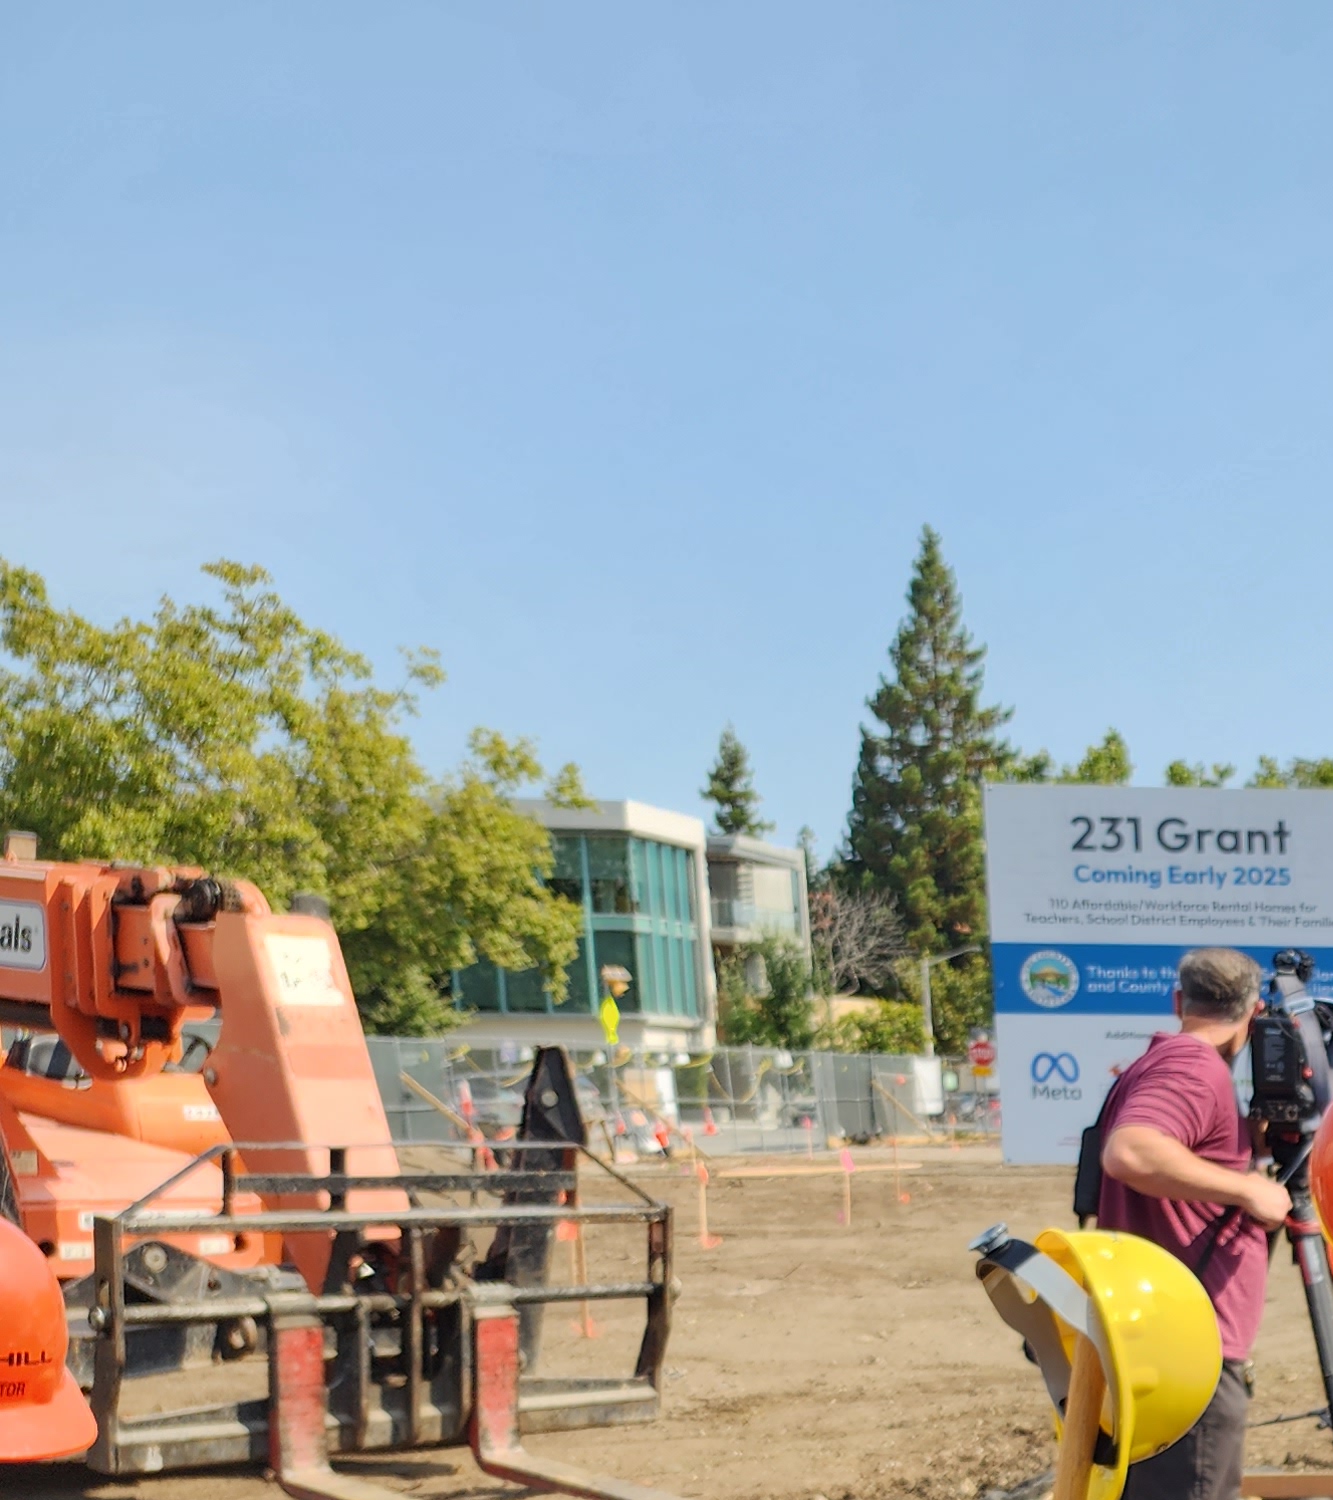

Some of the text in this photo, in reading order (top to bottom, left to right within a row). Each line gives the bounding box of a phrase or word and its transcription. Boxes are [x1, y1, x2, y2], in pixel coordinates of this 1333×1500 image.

[1070, 816, 1291, 855] 231 Grant
[1074, 864, 1291, 890] Coming Early 2025
[1072, 898, 1209, 912] Affordable/Workforce
[1212, 900, 1250, 912] Rental
[1254, 901, 1297, 913] Homes
[1299, 902, 1318, 913] for
[1024, 913, 1084, 926] Teachers,
[1086, 913, 1129, 925] School
[1131, 914, 1177, 926] District
[1179, 915, 1246, 929] Employees
[1248, 916, 1257, 927] &
[1258, 916, 1291, 928] Their
[1085, 965, 1139, 979] Thanks
[1141, 966, 1158, 979] to
[1087, 981, 1116, 993] and
[1119, 981, 1170, 997] County
[1031, 1085, 1082, 1101] Meta
